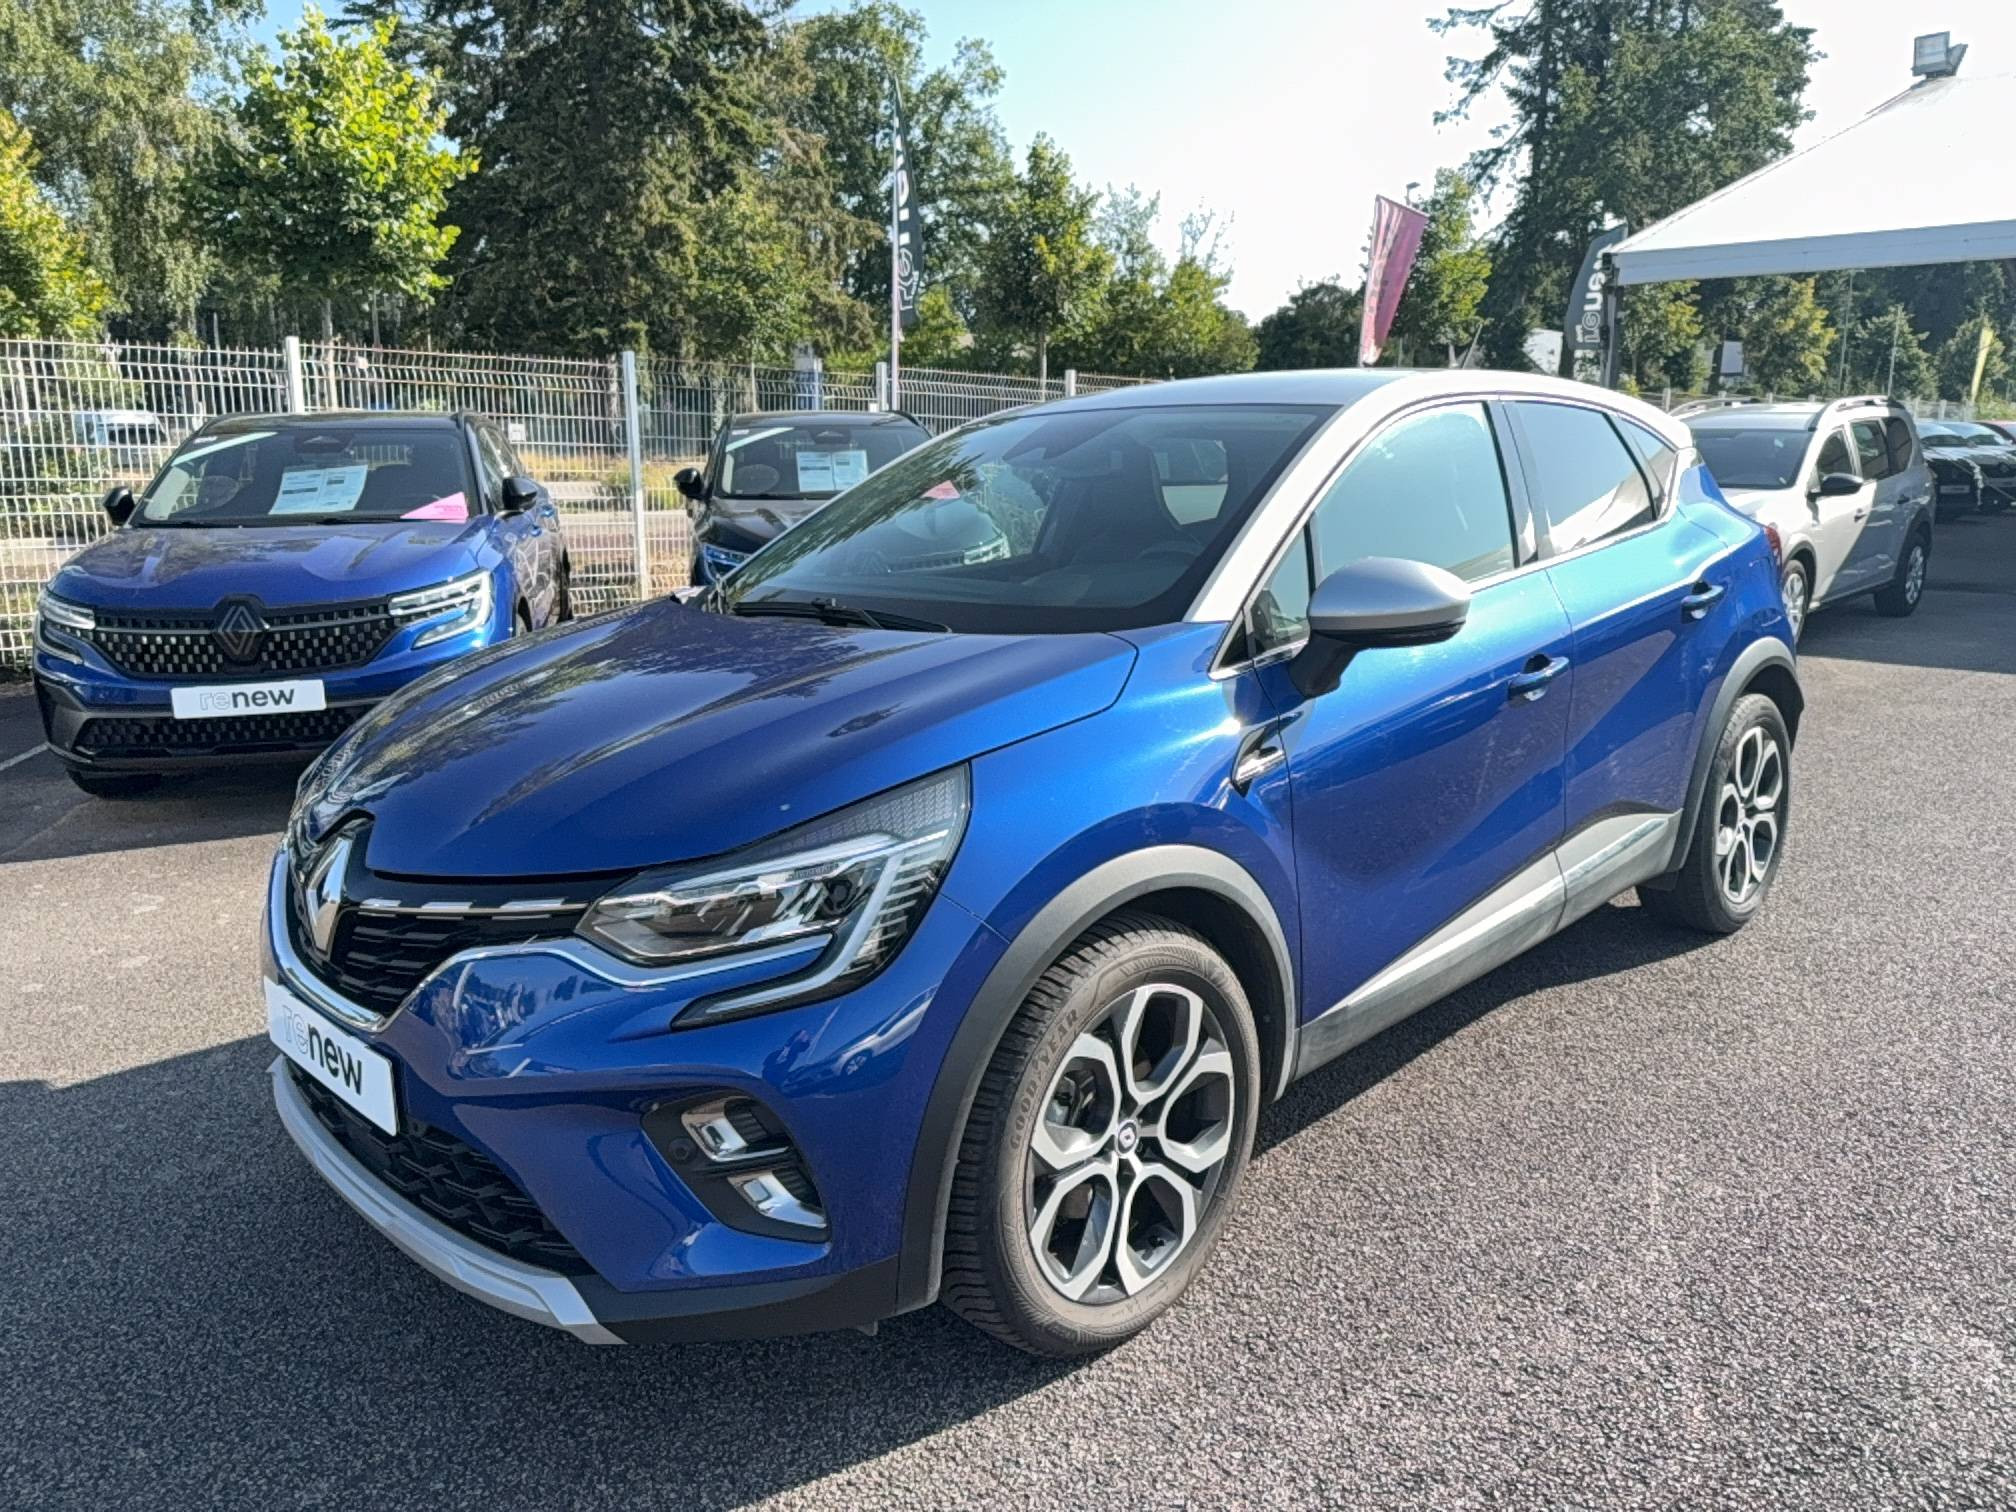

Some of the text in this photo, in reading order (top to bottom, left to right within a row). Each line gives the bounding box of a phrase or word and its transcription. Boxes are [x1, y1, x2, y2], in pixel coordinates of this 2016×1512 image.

[199, 688, 295, 711] renew
[283, 1005, 362, 1096] renew
[1010, 1009, 1078, 1149] GOODYEAR
